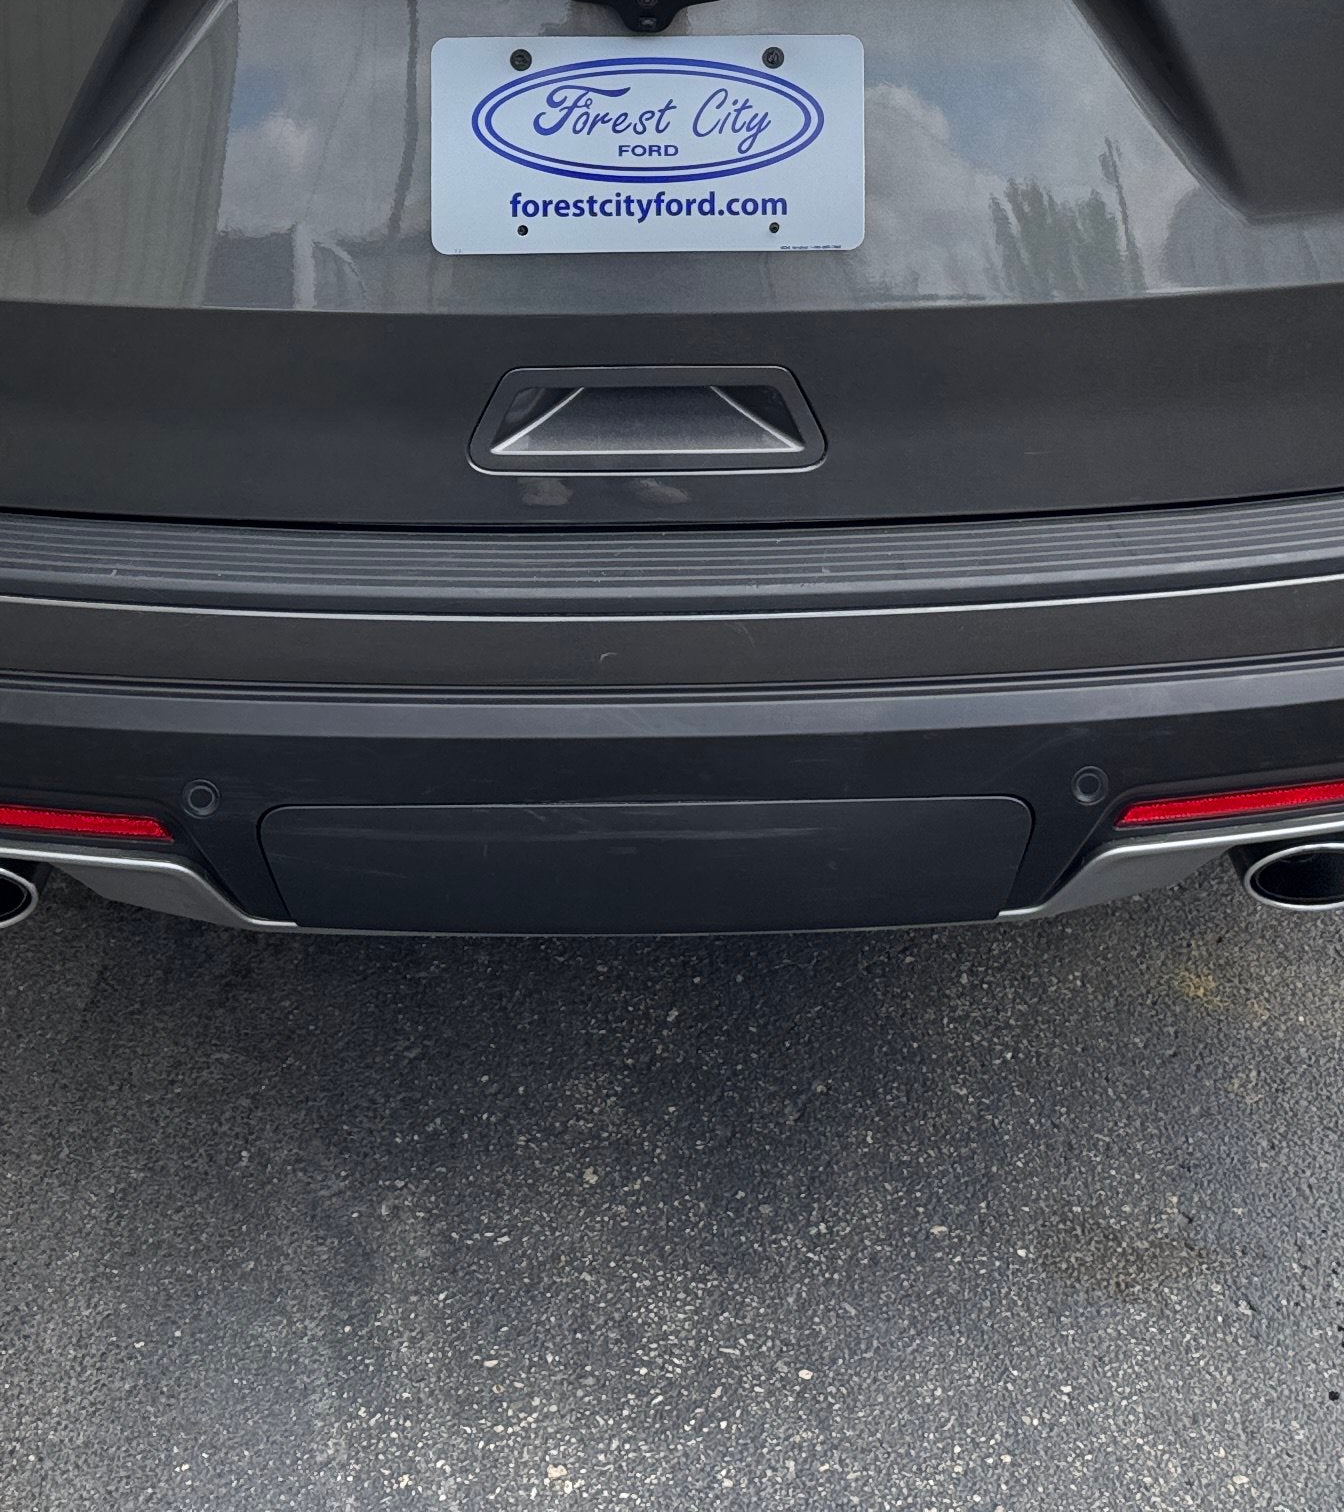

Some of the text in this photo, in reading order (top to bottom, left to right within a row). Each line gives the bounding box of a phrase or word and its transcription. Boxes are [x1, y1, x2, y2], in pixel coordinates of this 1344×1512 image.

[533, 85, 771, 154] Forest City
[618, 144, 679, 157] FORD
[510, 192, 788, 223] forestcityford.com
